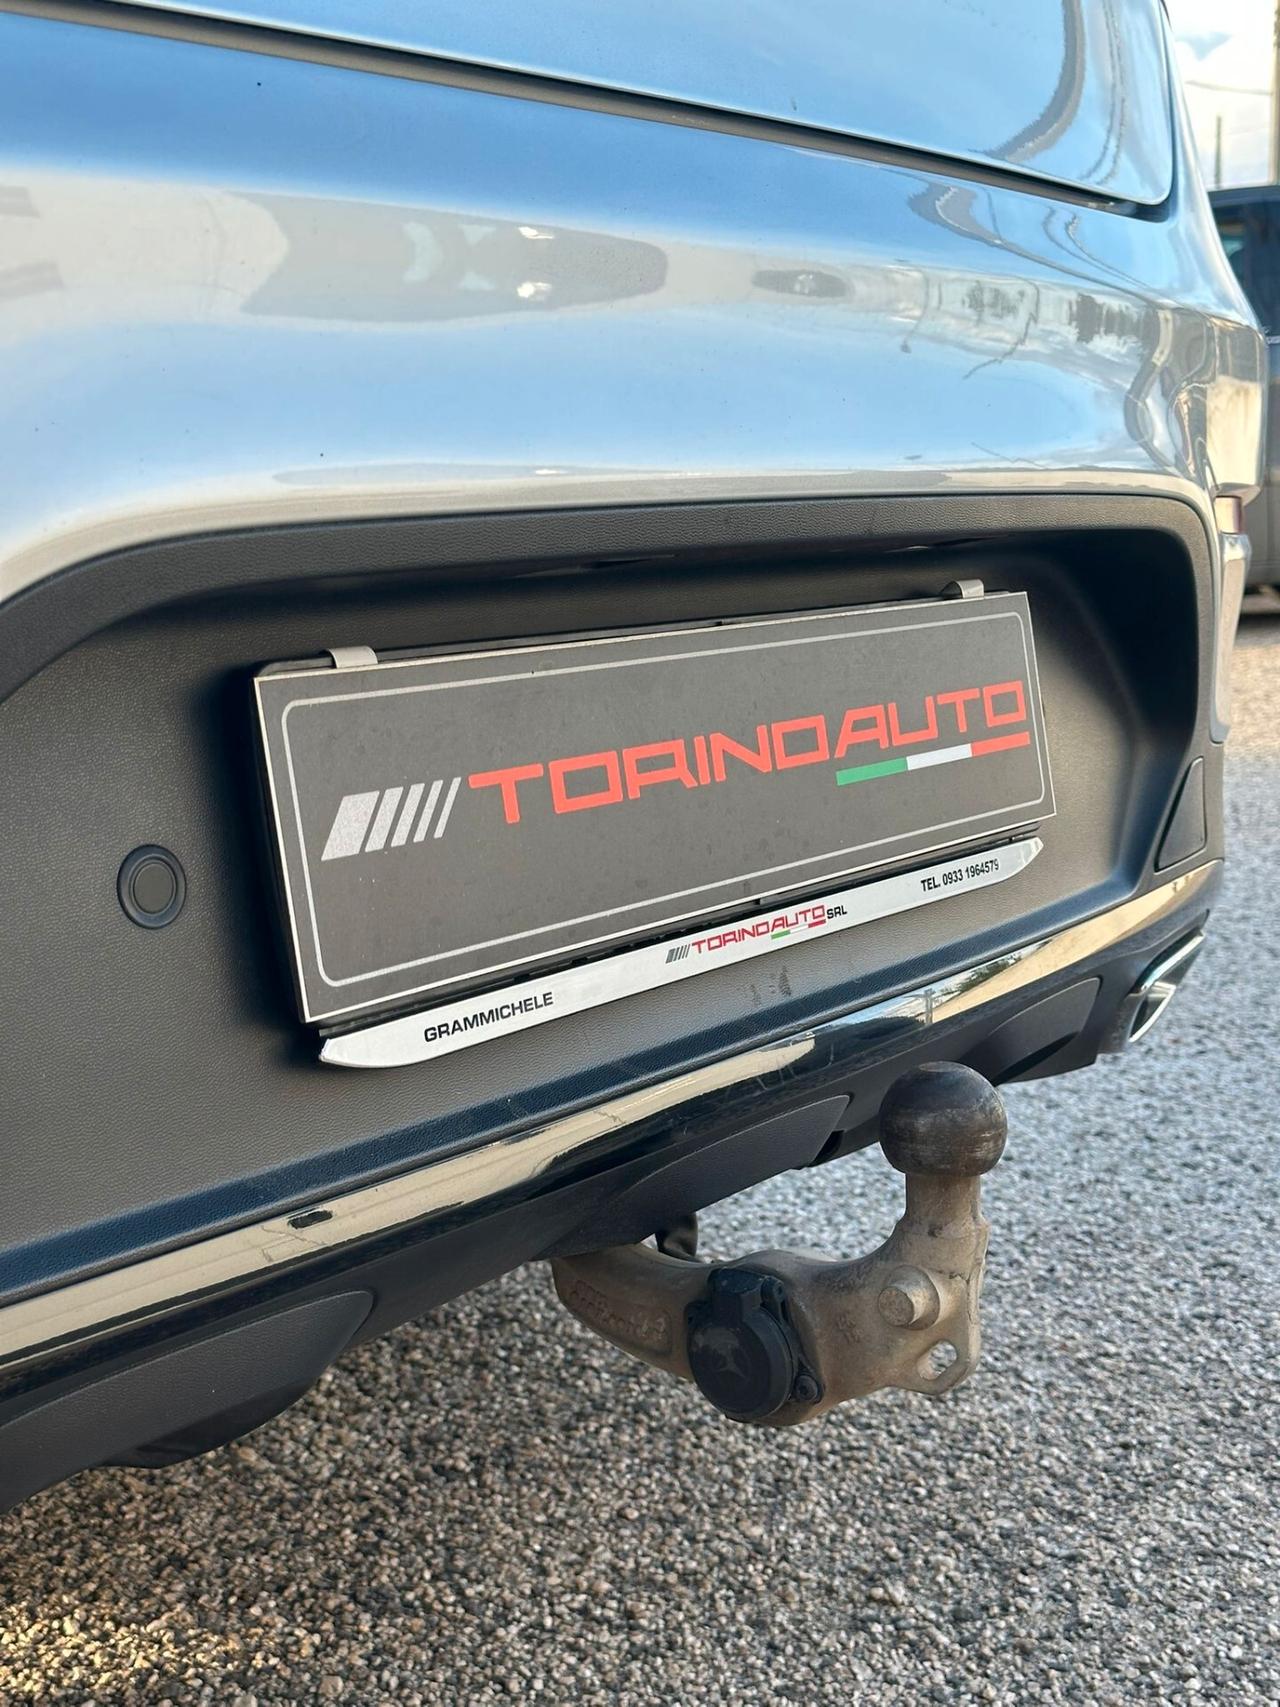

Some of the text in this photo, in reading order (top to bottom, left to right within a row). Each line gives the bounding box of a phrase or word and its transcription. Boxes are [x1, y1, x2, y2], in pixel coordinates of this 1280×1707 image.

[468, 680, 1028, 824] TORINOAUTO
[920, 858, 999, 892] TEL. 0933 1964579
[691, 904, 848, 954] TORINOAUTO SRL
[424, 991, 554, 1043] GRAMMICHELE
